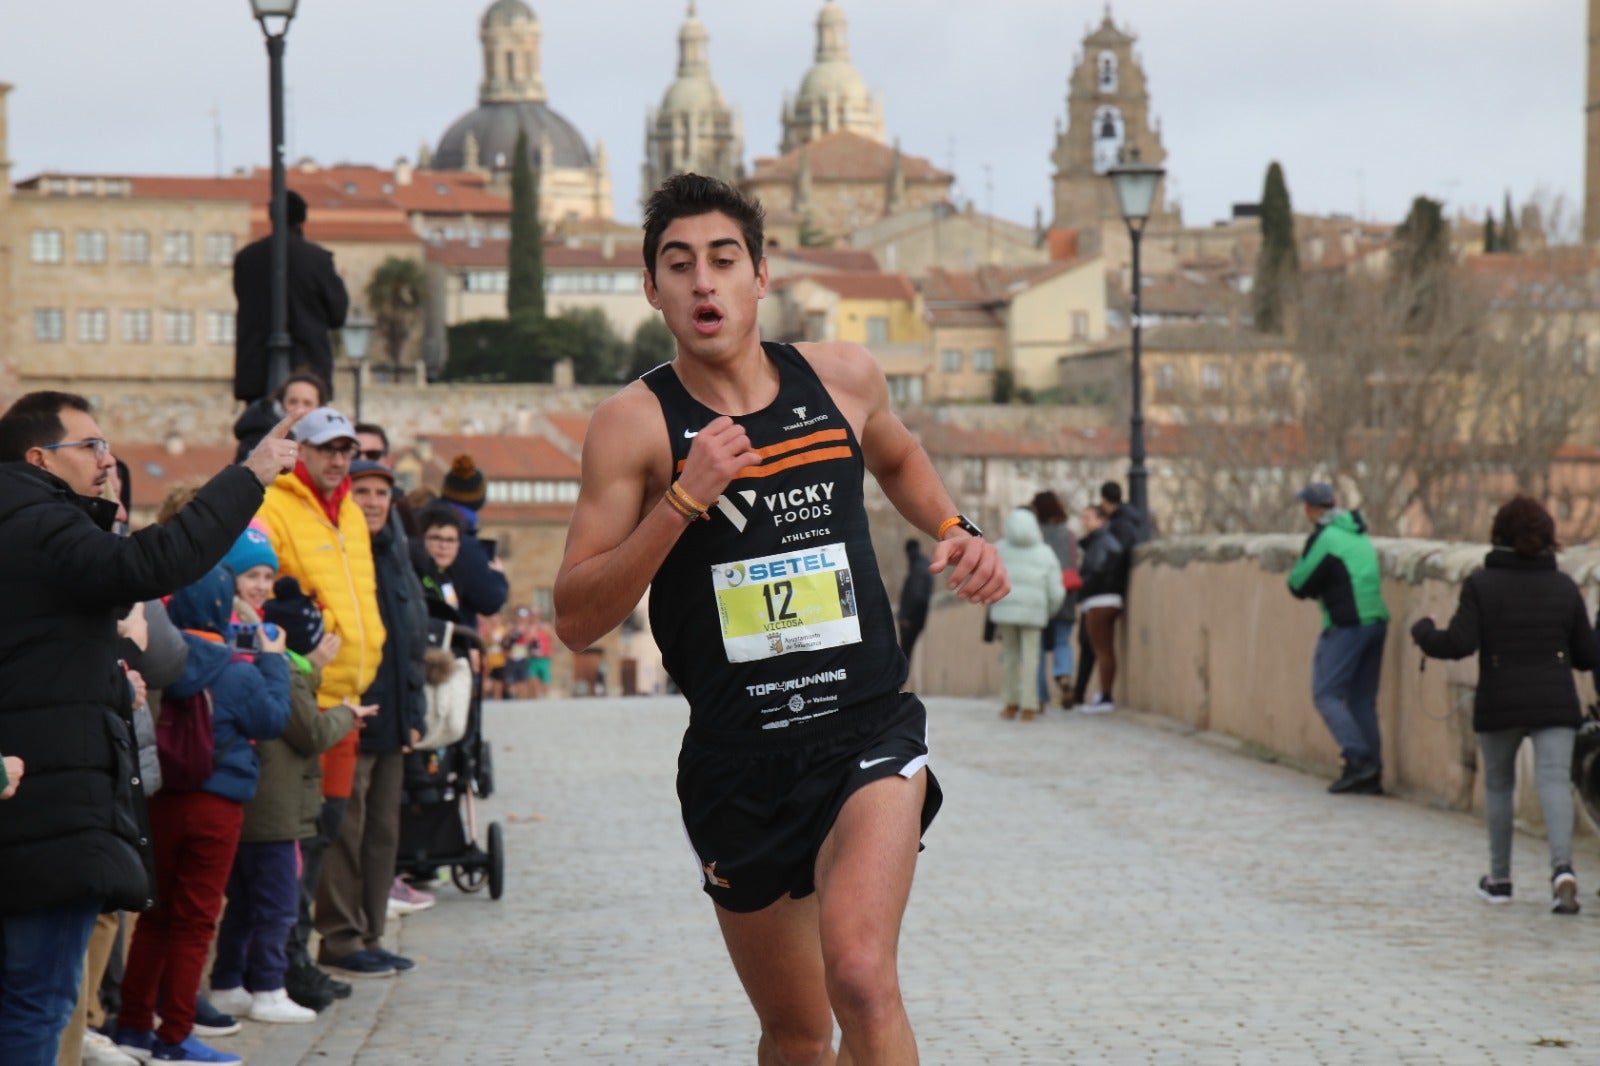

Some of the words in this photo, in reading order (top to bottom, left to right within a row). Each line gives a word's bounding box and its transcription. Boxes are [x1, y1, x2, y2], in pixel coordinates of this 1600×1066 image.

[763, 482, 835, 512] VICKY
[773, 504, 833, 527] FOODS
[781, 528, 831, 544] ATHLETICS
[749, 553, 836, 581] SETEL
[762, 580, 798, 622] 12
[763, 618, 804, 632] VICIOSA
